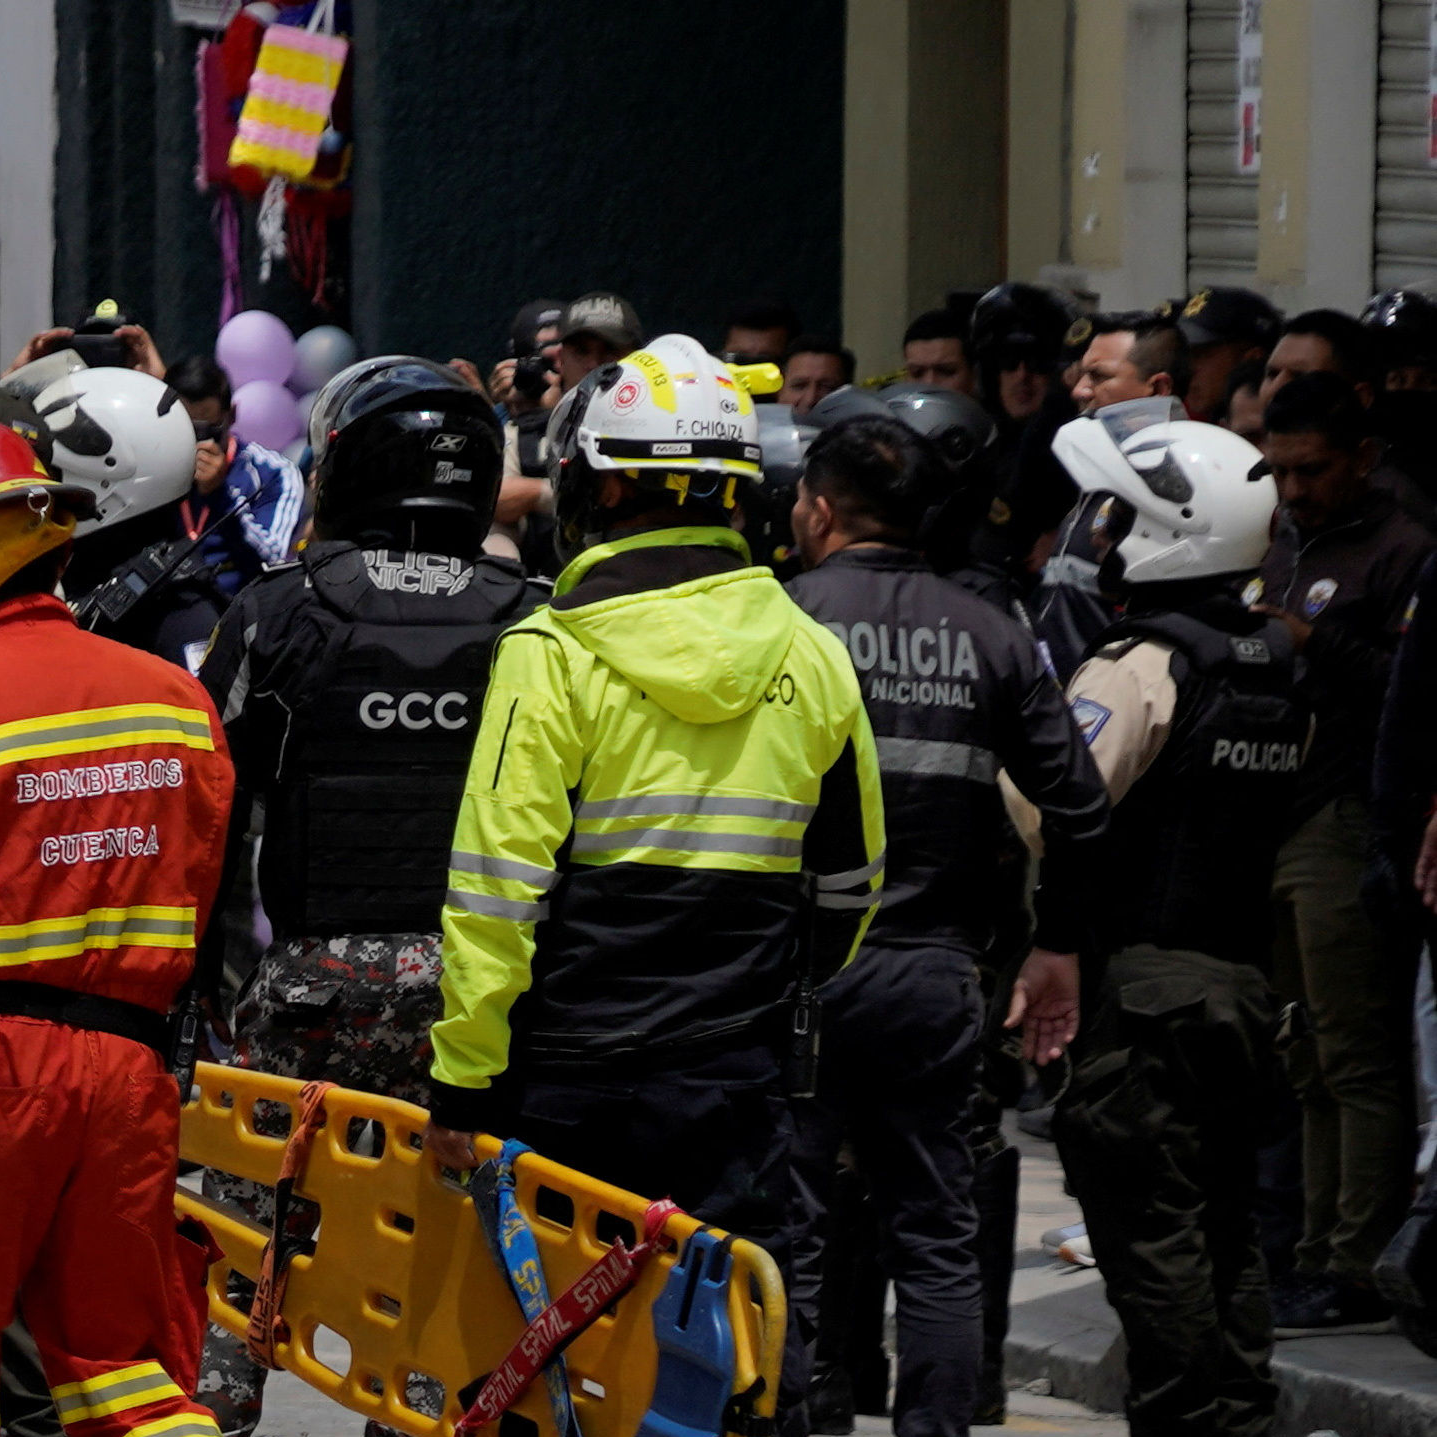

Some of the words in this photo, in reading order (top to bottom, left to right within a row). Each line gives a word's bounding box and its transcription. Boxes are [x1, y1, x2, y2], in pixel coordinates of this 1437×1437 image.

[359, 691, 469, 730] GCC
[870, 677, 976, 709] NACIONAL
[1212, 738, 1298, 772] POLICIA
[16, 758, 184, 804] BOMBEROS
[40, 824, 160, 867] CUENCA
